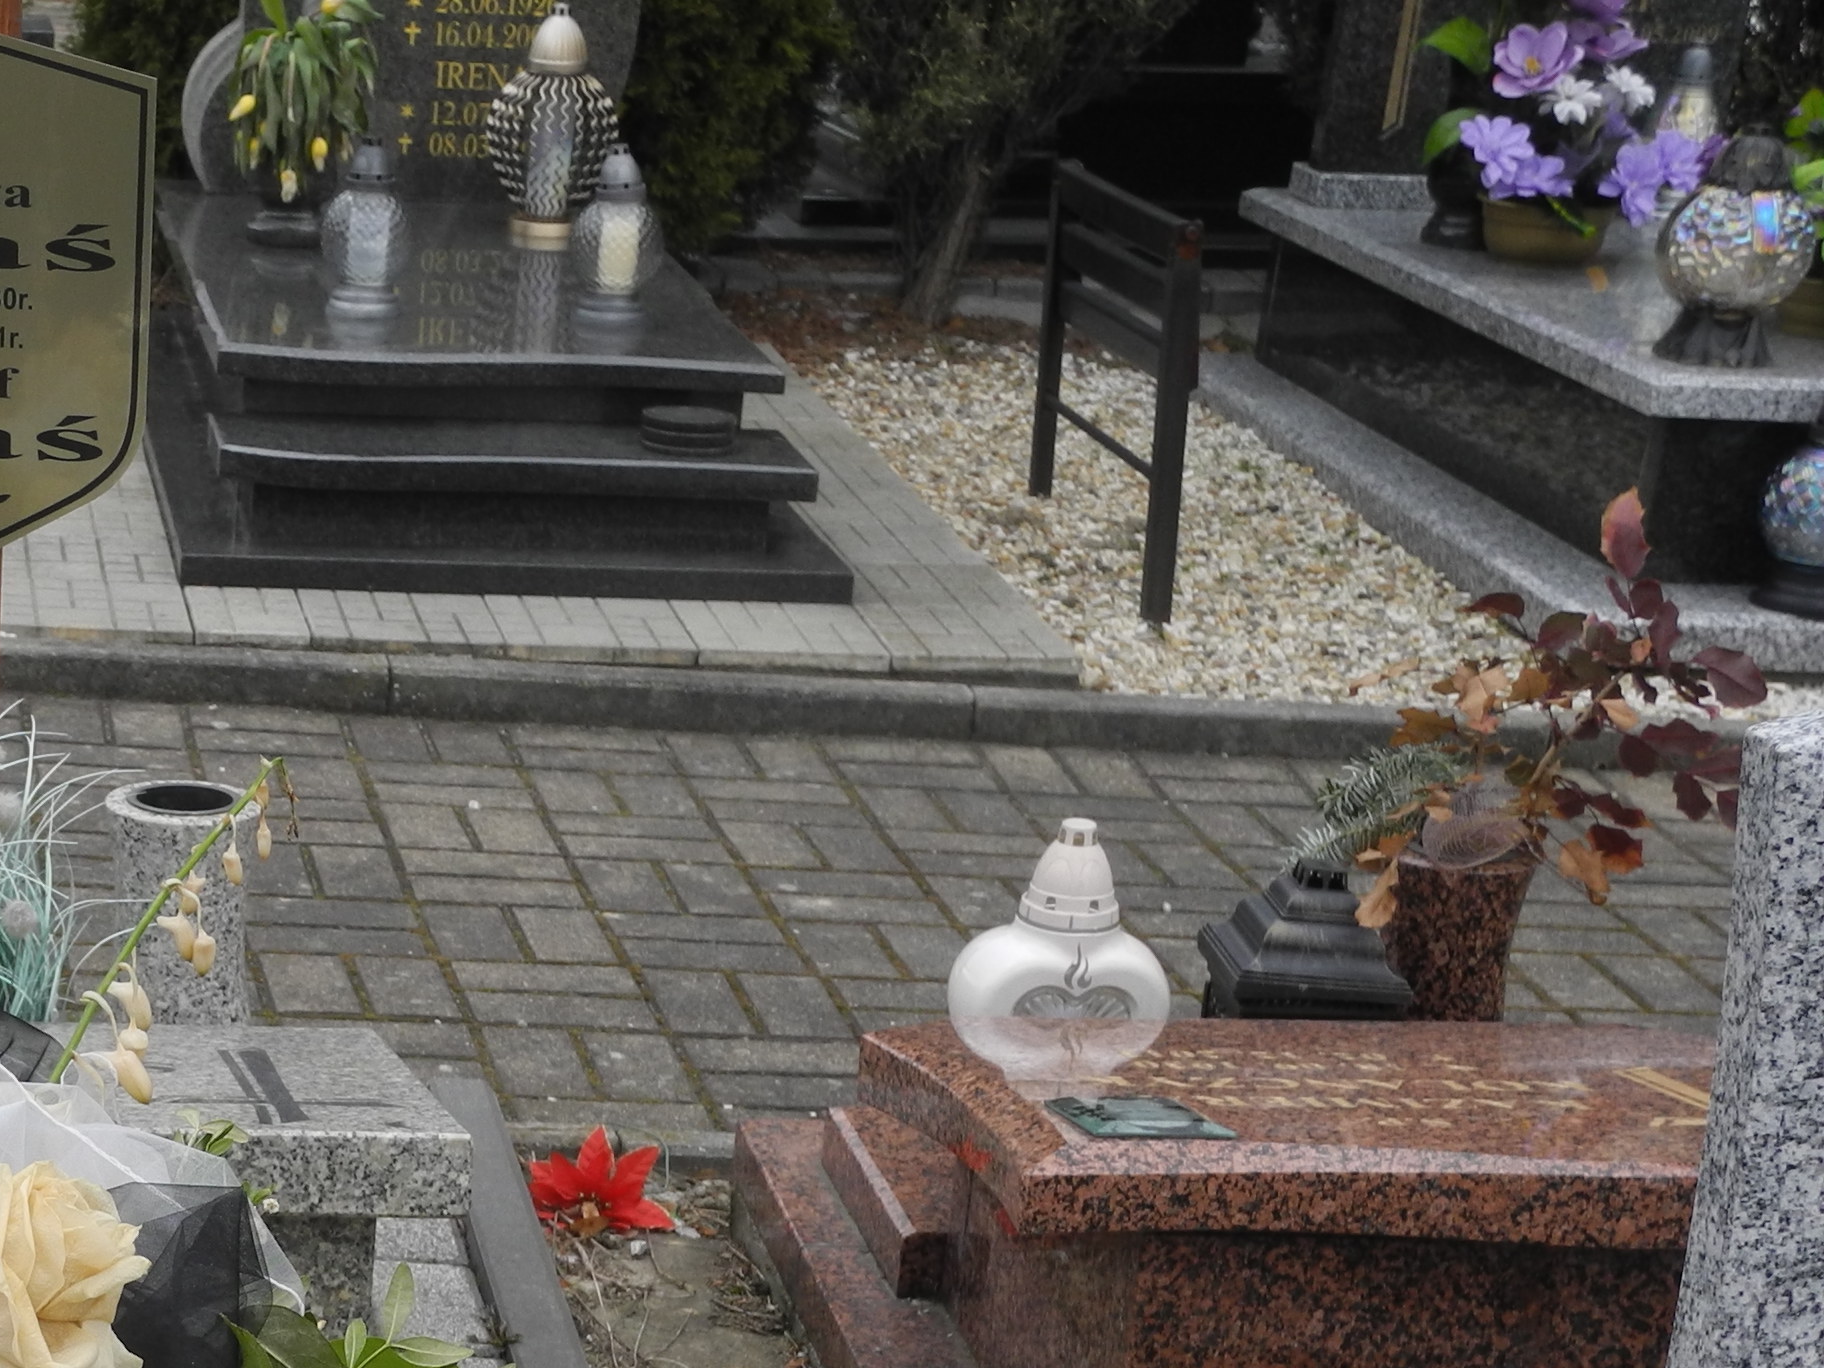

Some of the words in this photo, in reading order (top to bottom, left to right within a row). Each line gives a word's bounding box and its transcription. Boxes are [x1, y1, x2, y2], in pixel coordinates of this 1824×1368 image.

[435, 60, 525, 90] IREN
[430, 100, 492, 127] 12.07
[429, 132, 492, 159] 08.03
